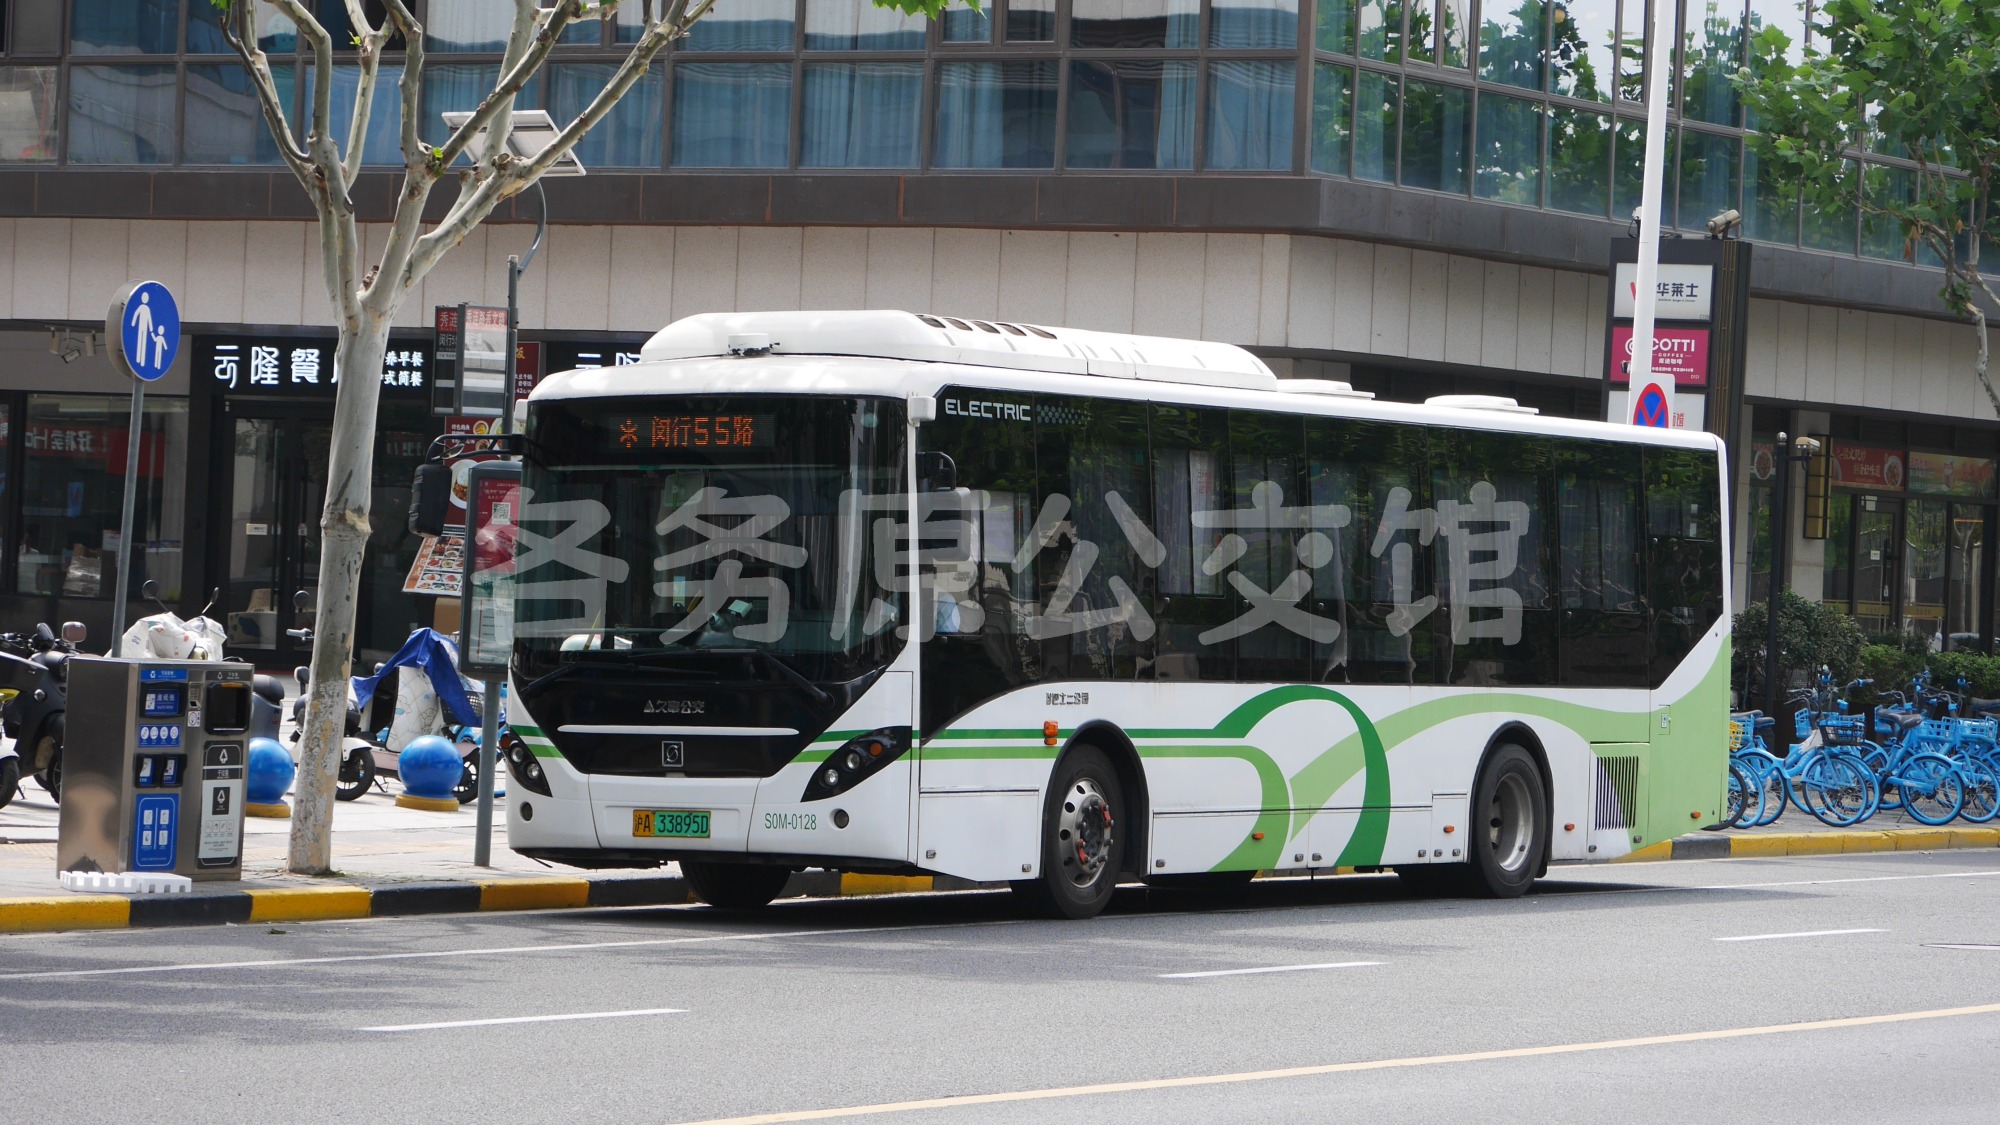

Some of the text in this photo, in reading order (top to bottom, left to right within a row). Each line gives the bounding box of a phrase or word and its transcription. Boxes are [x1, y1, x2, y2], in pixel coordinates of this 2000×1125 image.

[1656, 282, 1699, 298] 华莱士
[1652, 338, 1695, 353] COTTI
[214, 345, 338, 389] 云隆餐
[945, 398, 1031, 421] ELECTRIC
[651, 415, 754, 448] 闵行55路
